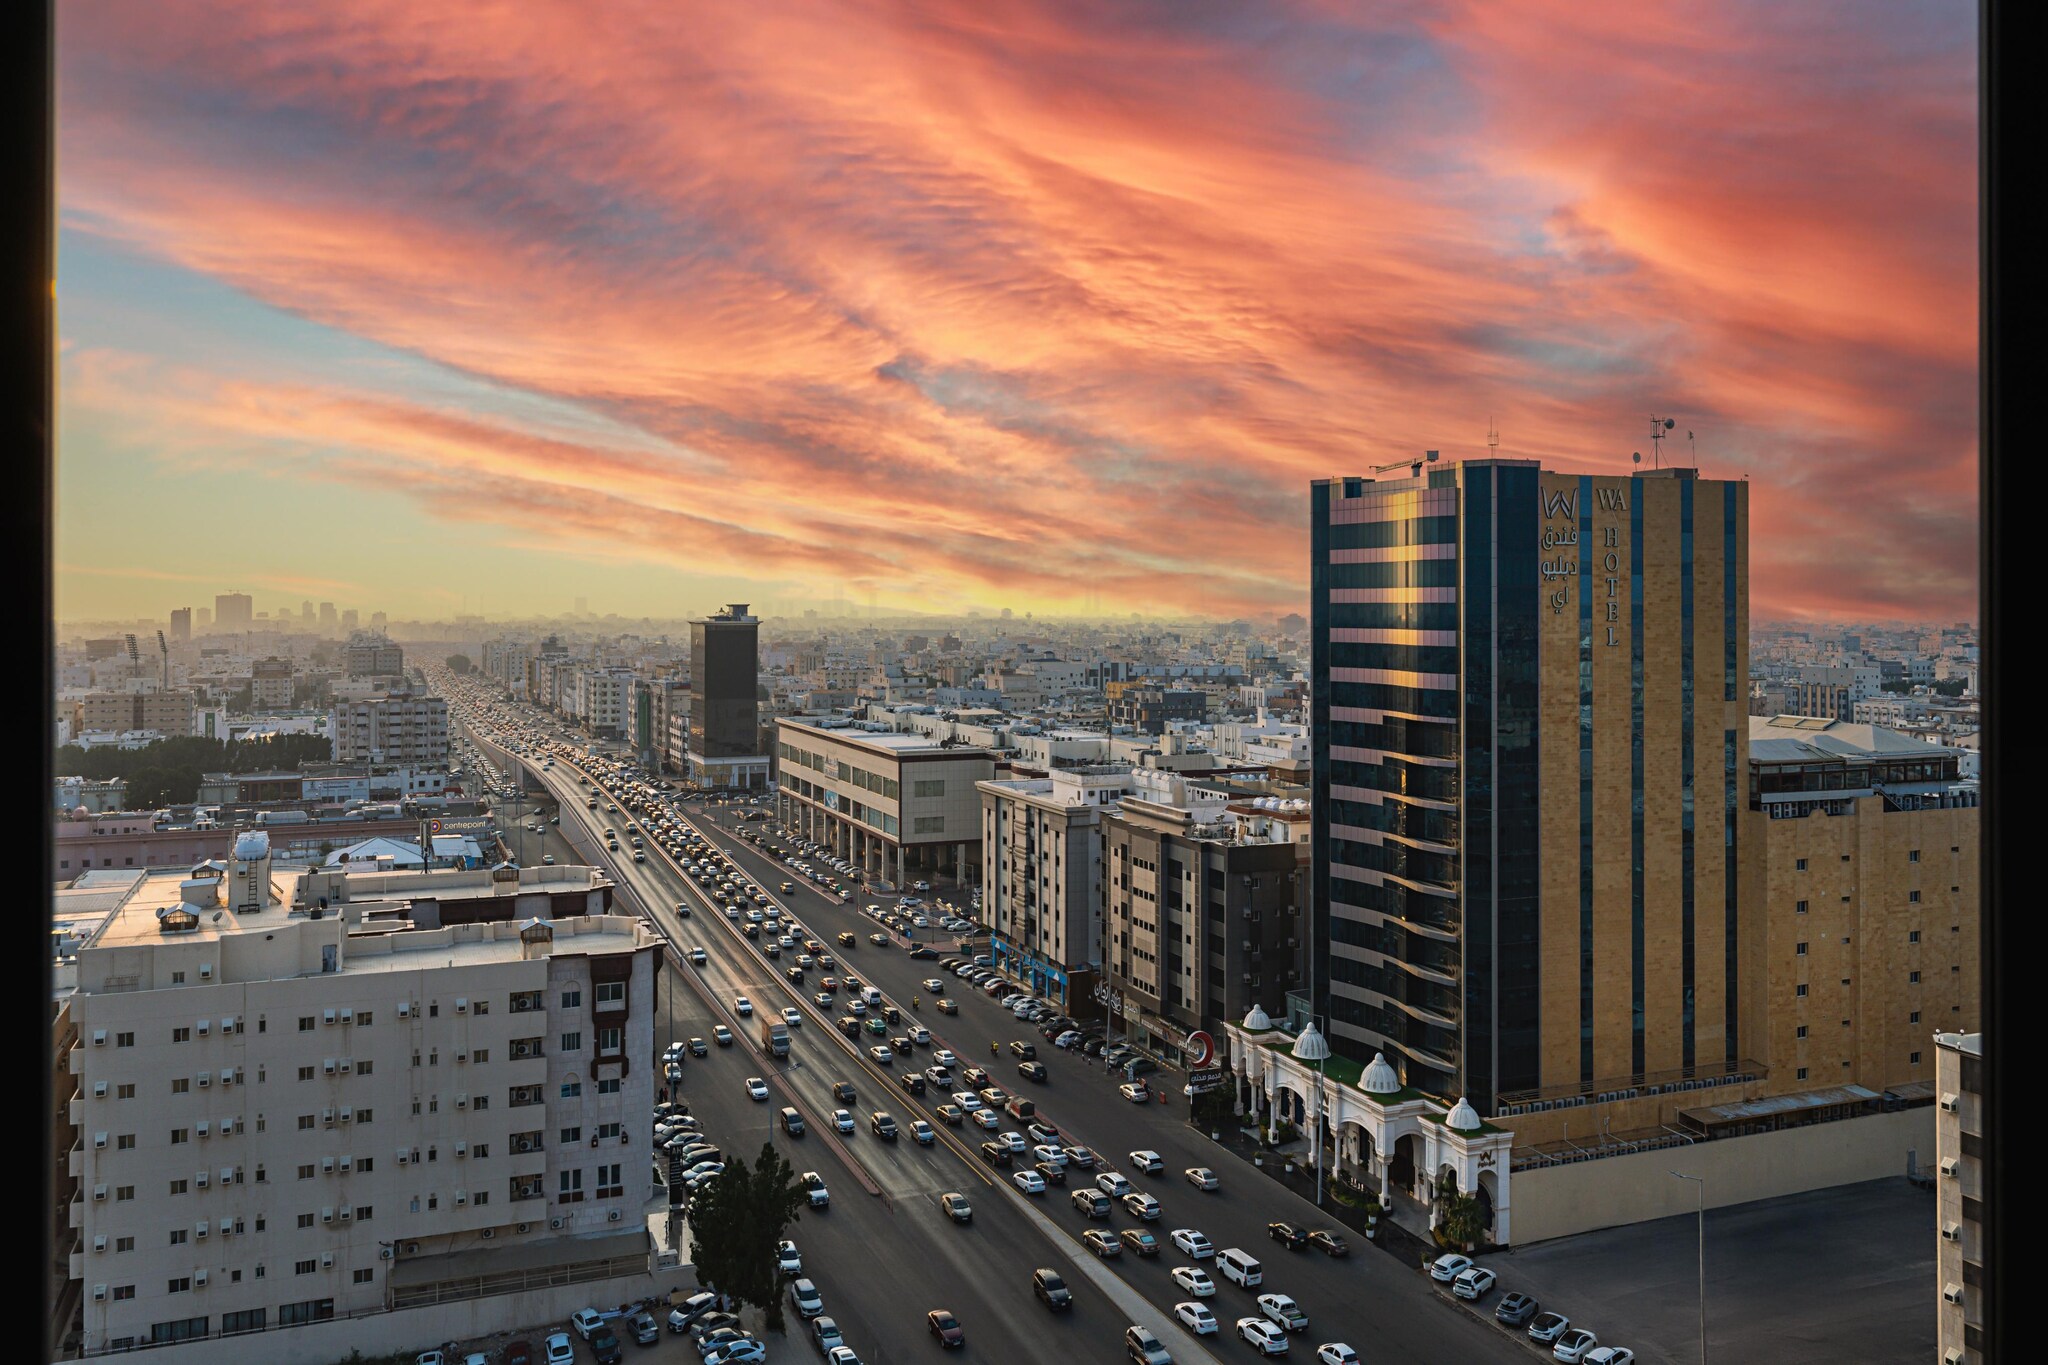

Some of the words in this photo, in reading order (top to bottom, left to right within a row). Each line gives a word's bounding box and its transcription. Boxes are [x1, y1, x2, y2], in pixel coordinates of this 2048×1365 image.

[1597, 488, 1627, 511] WA
[1541, 526, 1578, 550] فندق
[1541, 555, 1577, 581] دبليو
[1604, 527, 1619, 646] HOTEL
[1551, 586, 1569, 613] اي
[444, 821, 486, 829] centrepoint
